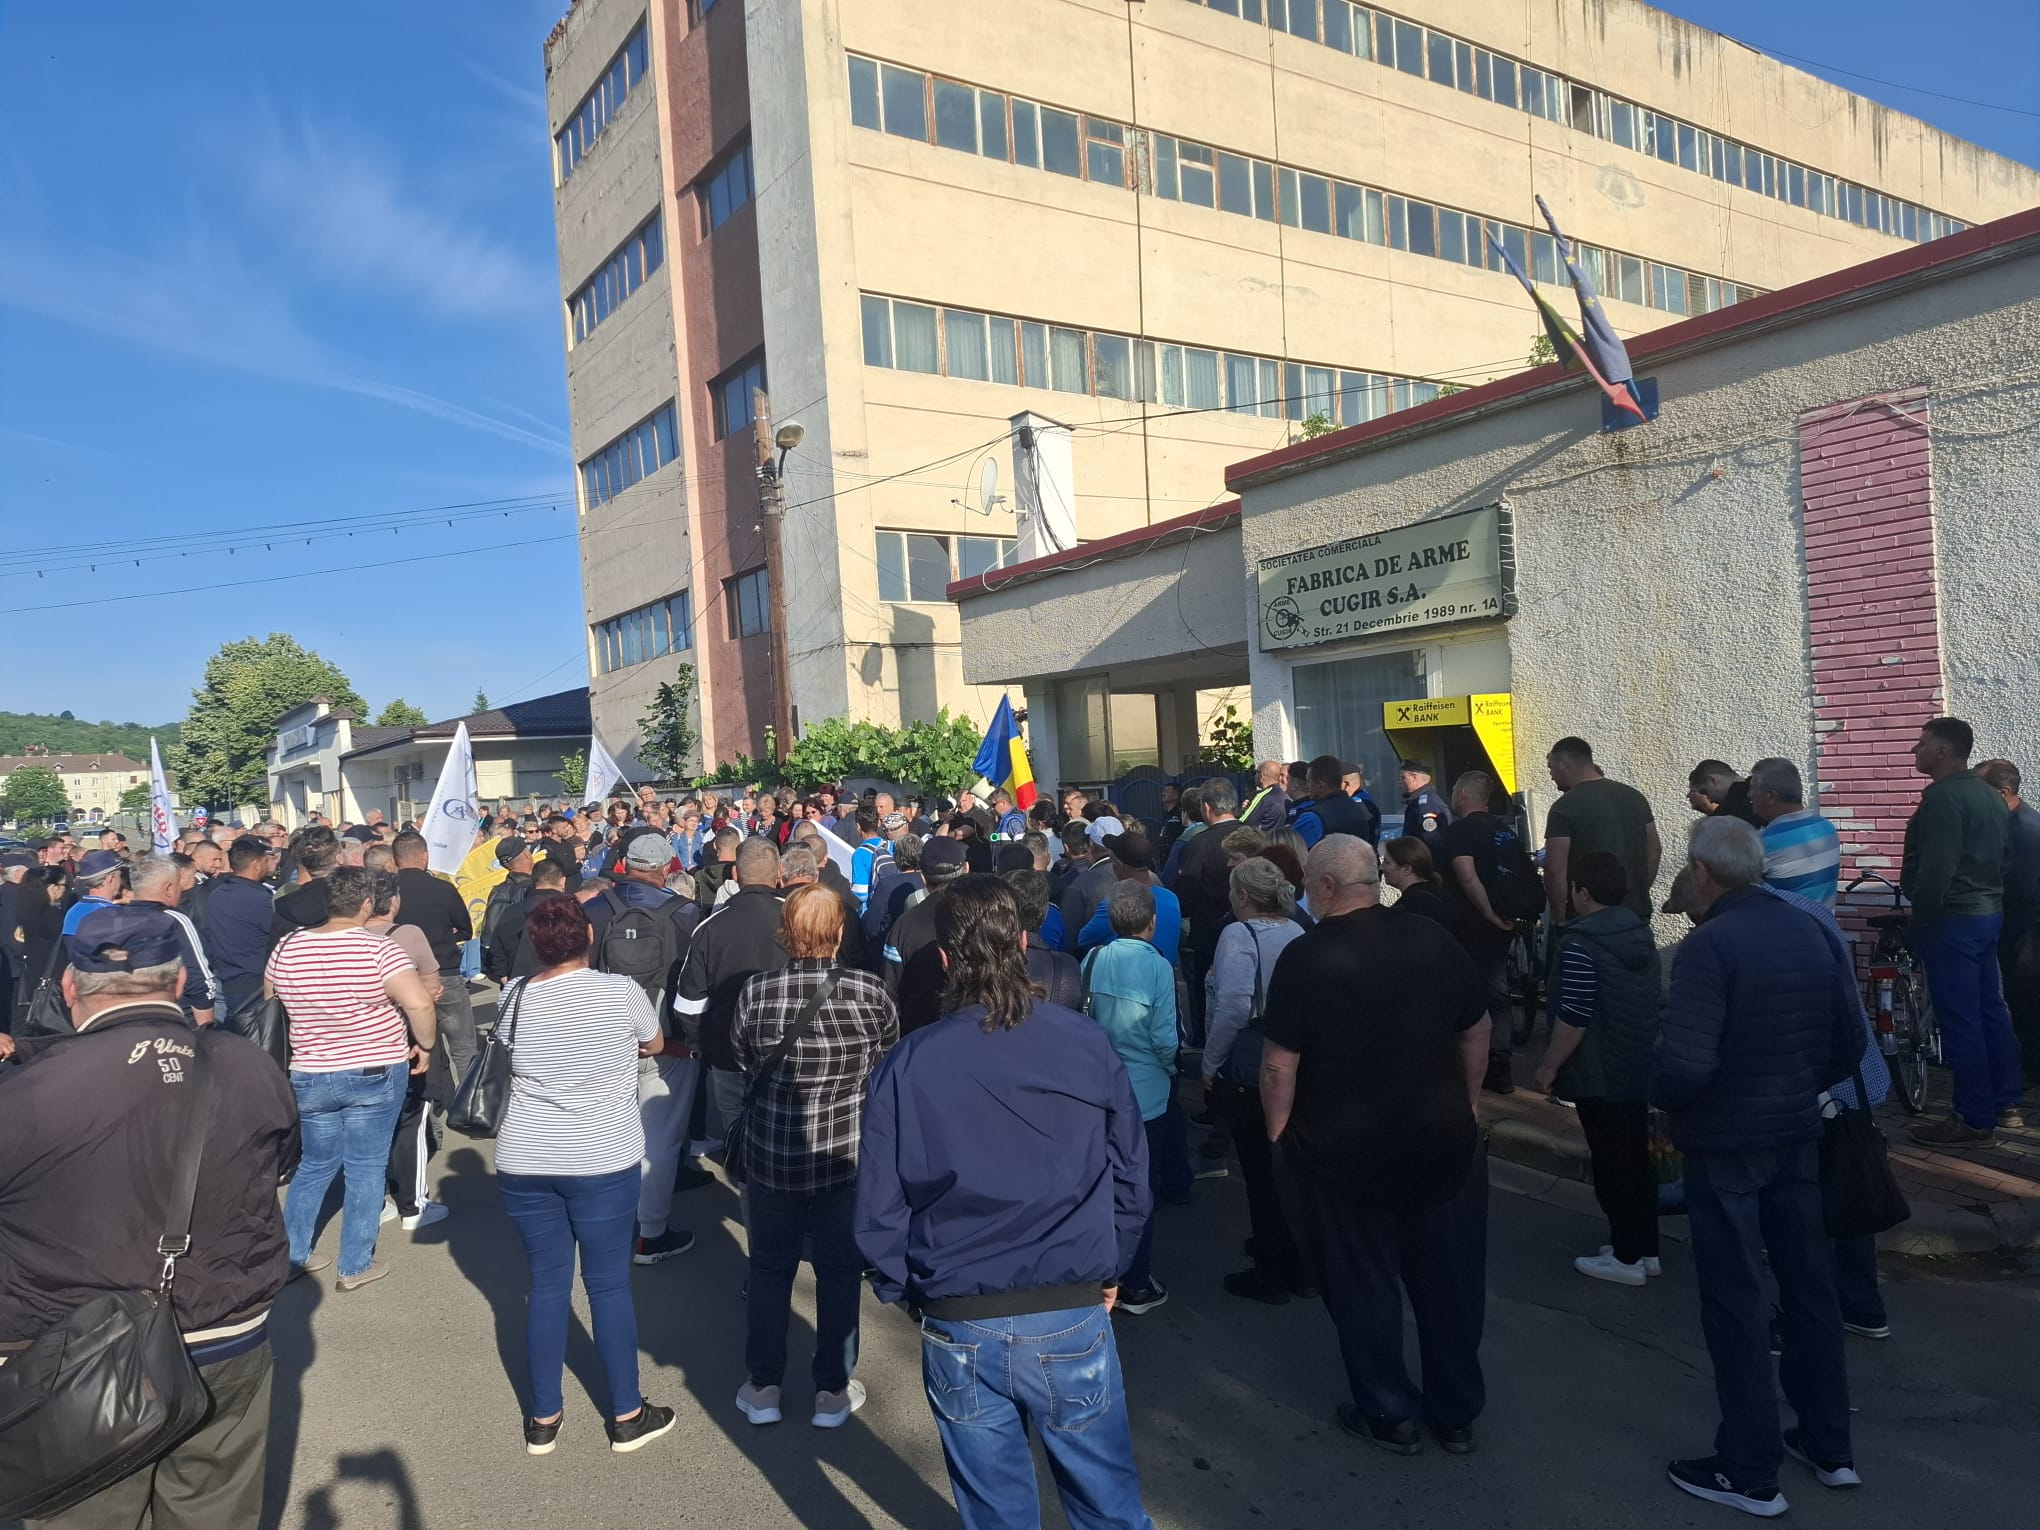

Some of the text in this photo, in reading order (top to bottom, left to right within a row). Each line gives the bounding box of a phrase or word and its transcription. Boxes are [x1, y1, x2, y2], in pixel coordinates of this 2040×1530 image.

[1260, 535, 1382, 571] SOCIETATEA COMERCIALA
[1286, 540, 1471, 595] FABRICA DE ARME
[1320, 582, 1427, 617] CUGIR S.A.
[1313, 597, 1499, 638] Str. 21 Decembrie 1989 nr. 1A
[1412, 702, 1456, 712] Raiffeisen
[1486, 708, 1503, 716] BANK
[1414, 713, 1439, 722] BANK
[127, 1040, 151, 1064] G
[157, 1057, 182, 1073] 50
[162, 1072, 184, 1083] CENT
